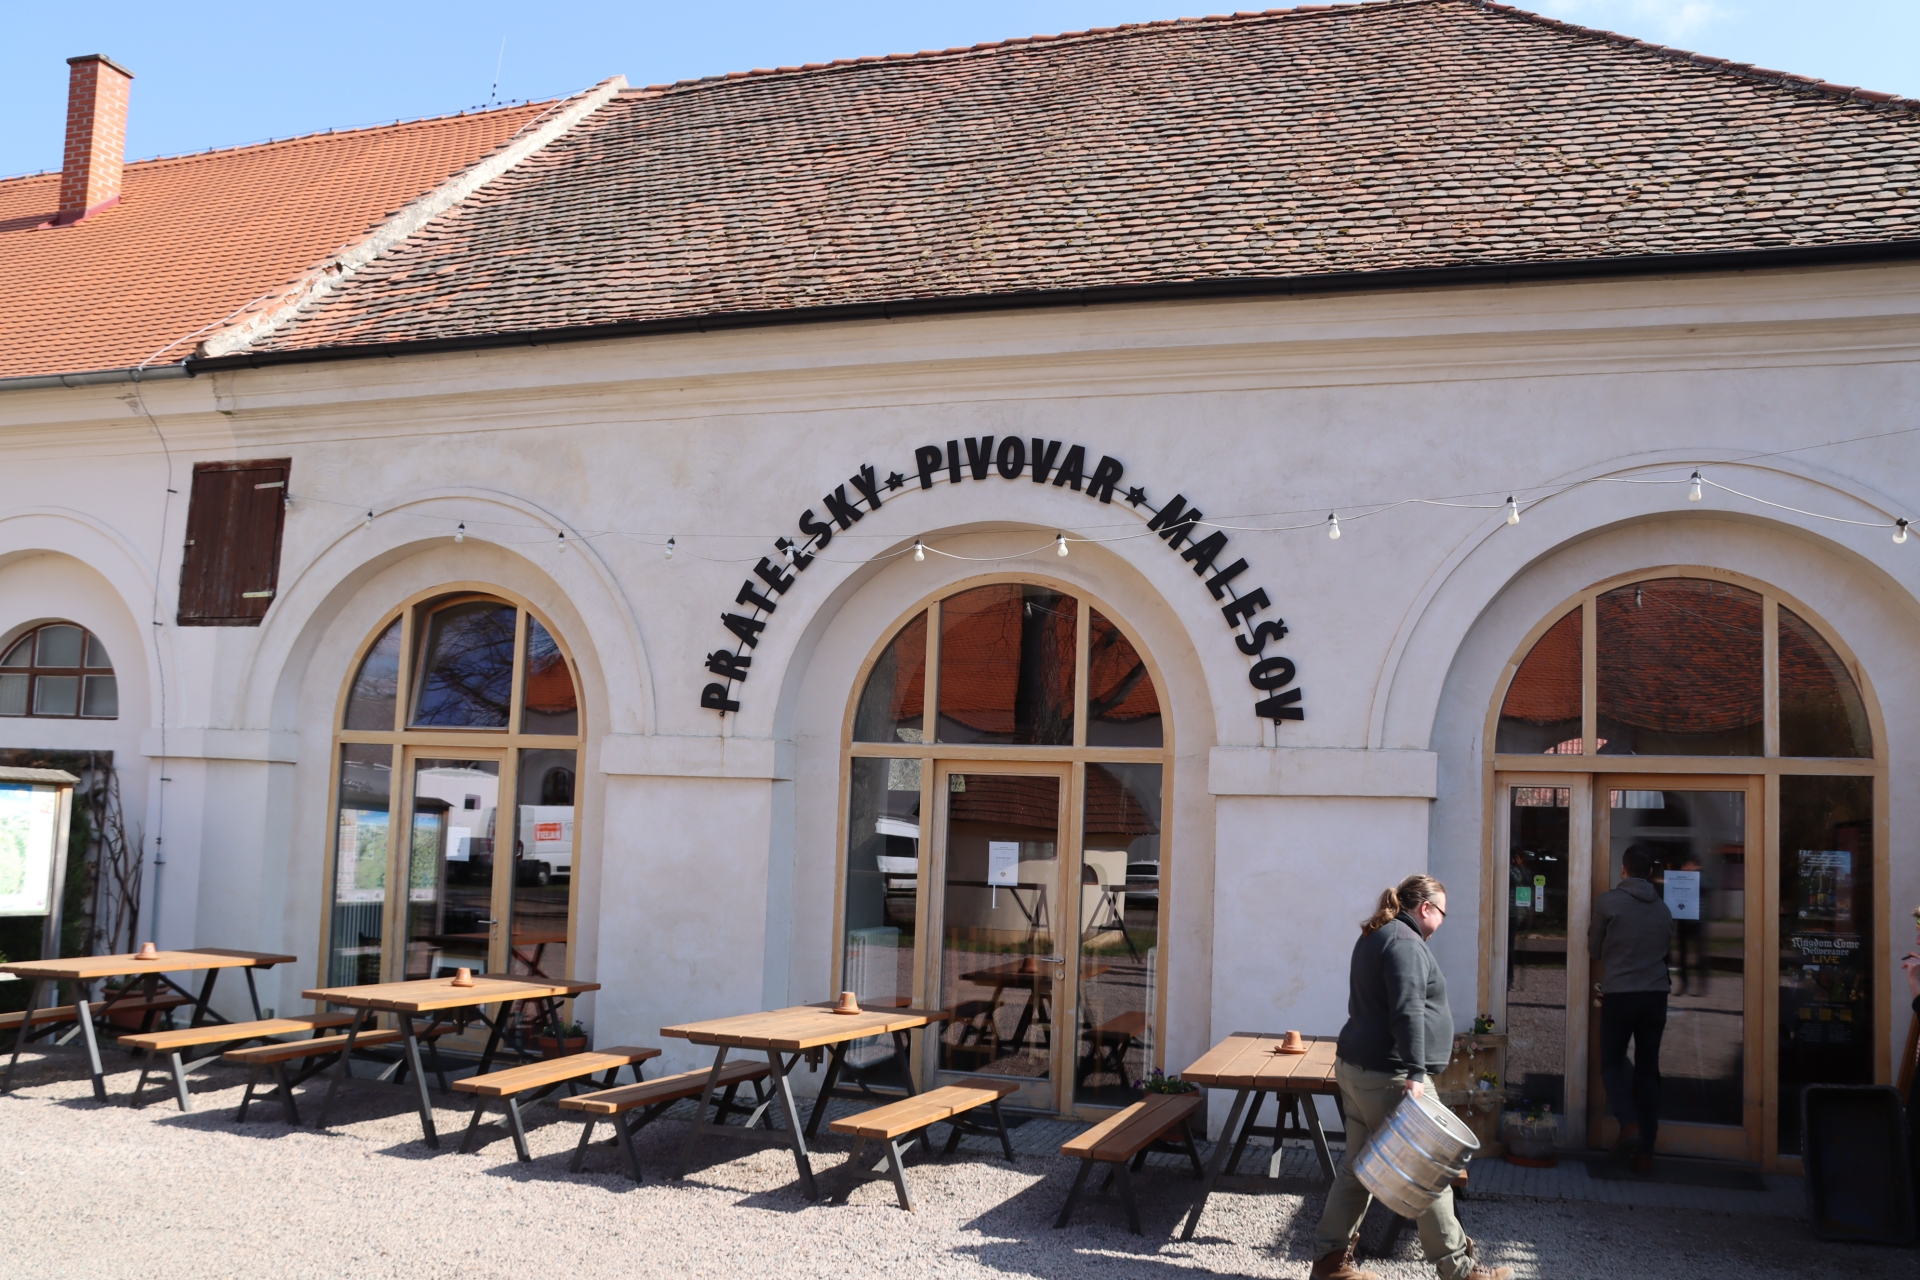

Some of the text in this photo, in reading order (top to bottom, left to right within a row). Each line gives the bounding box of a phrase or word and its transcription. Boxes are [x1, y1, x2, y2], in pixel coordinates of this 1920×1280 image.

[701, 436, 1304, 721] PŘÁTELSKÝ PIVOVAR MALEŠOV
[1791, 937, 1860, 949] Kingdom Come
[1802, 946, 1850, 956] Deliverance
[1812, 955, 1840, 964] LIVE
